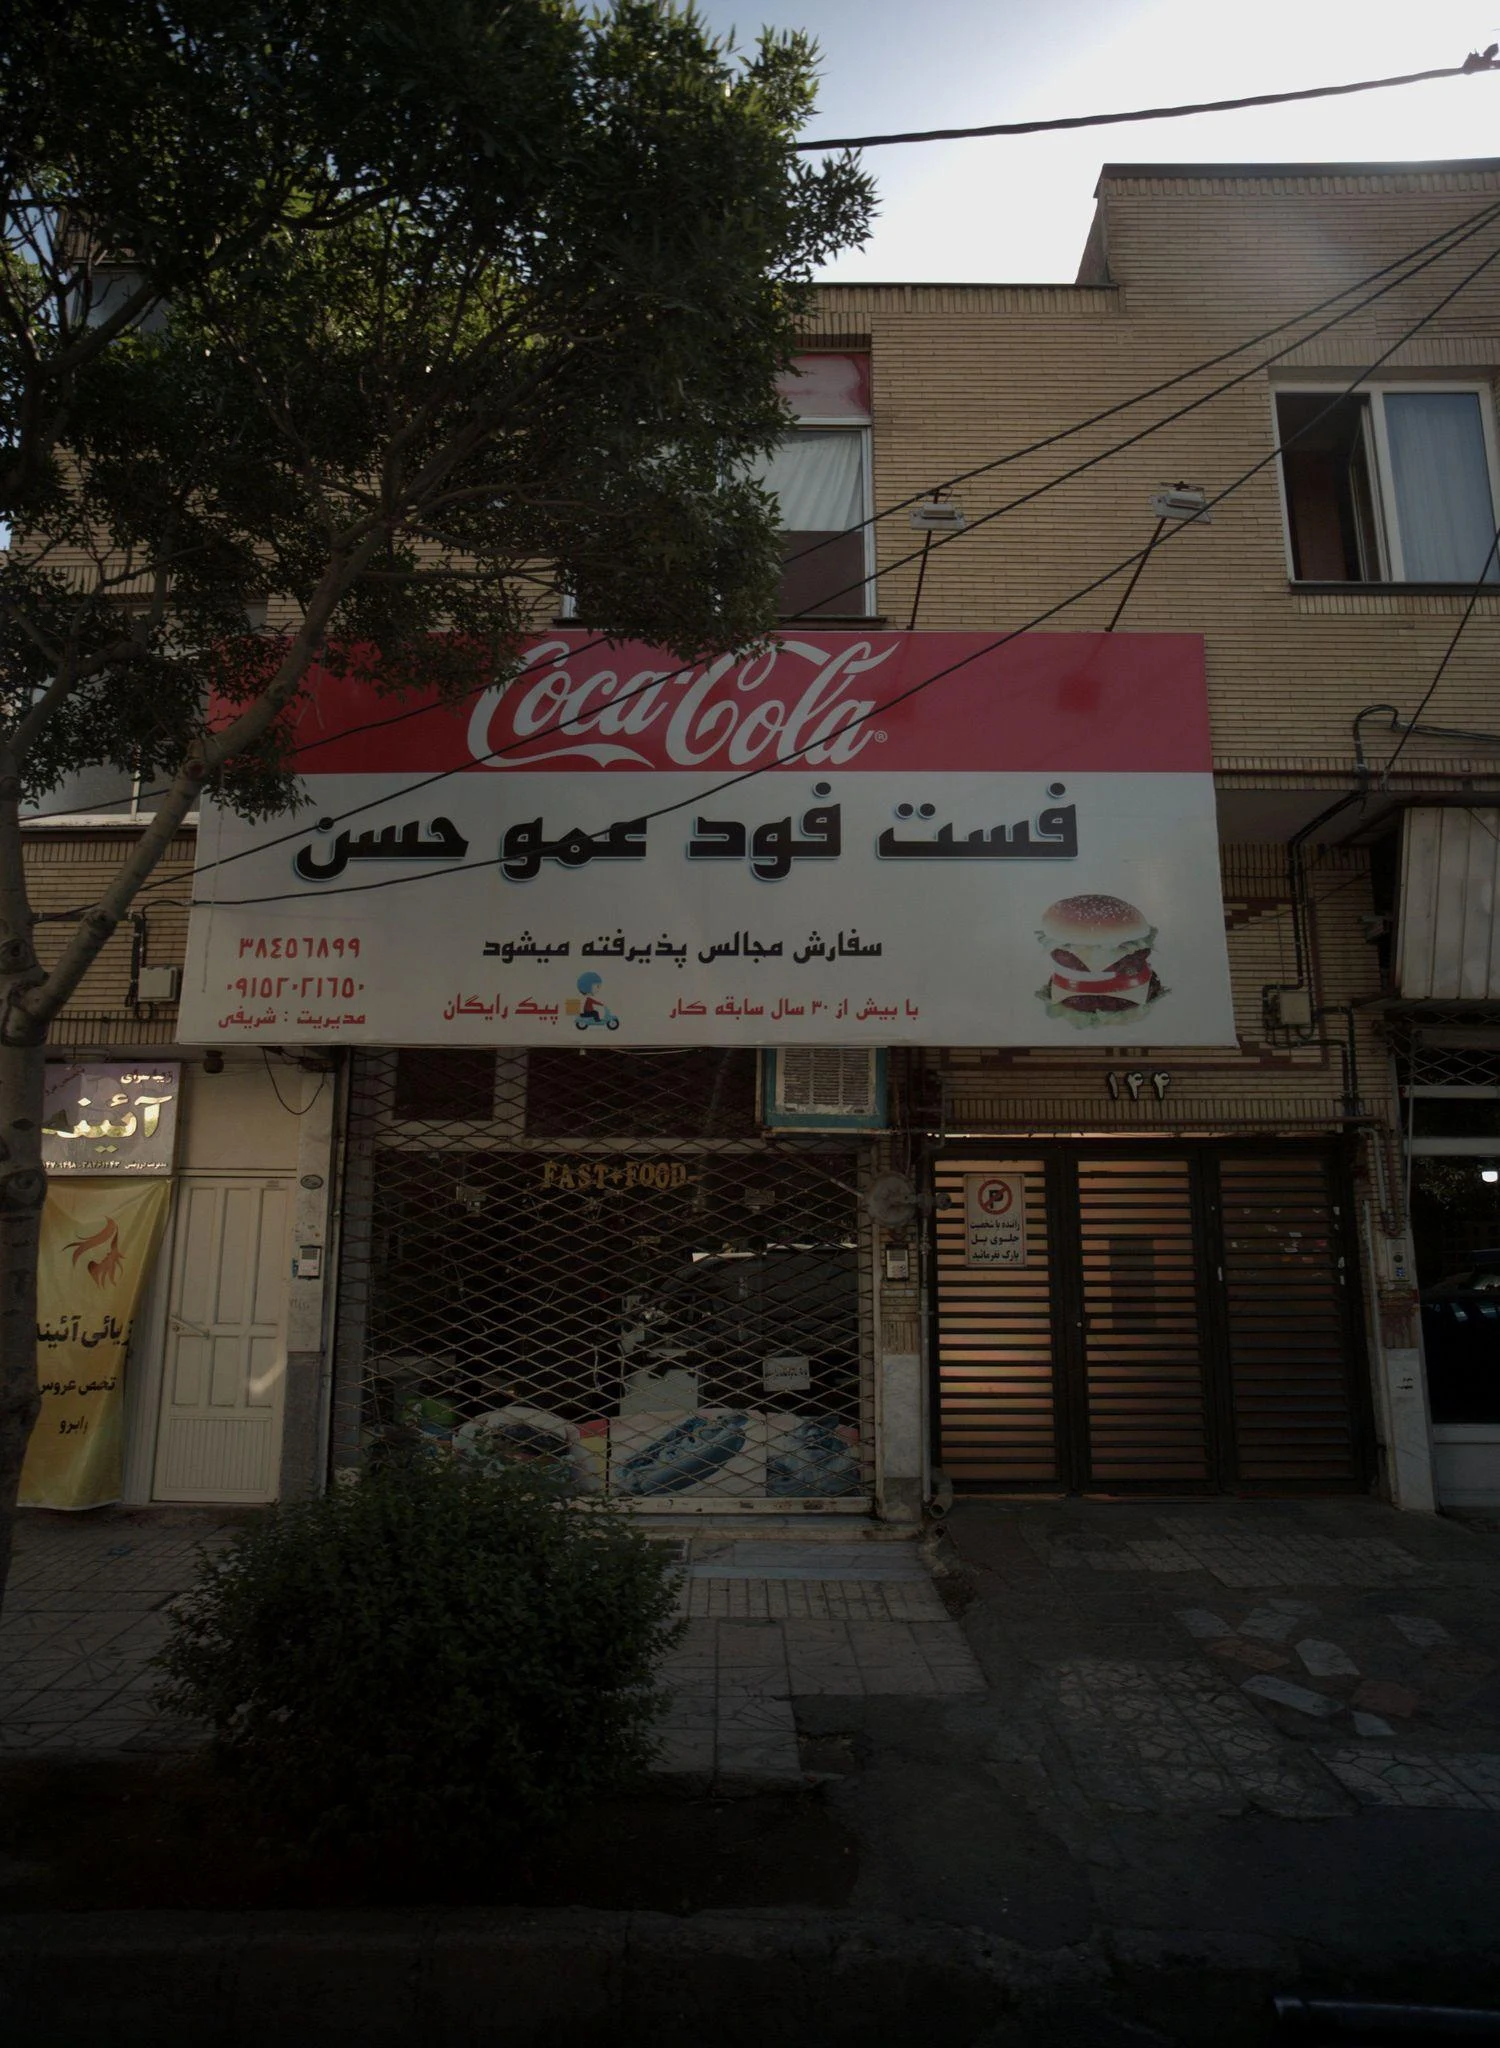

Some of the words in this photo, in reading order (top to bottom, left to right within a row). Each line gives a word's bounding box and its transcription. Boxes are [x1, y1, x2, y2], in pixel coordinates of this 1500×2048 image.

[467, 639, 900, 768] Coca-Cola
[687, 782, 842, 880] فود
[877, 782, 1078, 859] فست
[296, 816, 469, 881] حسن
[502, 816, 647, 881] عمو
[483, 930, 570, 964] میشود
[582, 928, 687, 968] پذیرفته
[698, 931, 783, 964] مجالس
[793, 928, 882, 964] سفارش
[297, 1010, 366, 1029] مدیریت
[443, 993, 508, 1021] رایگان
[515, 997, 559, 1025] پیک
[669, 998, 707, 1019] کار
[715, 996, 764, 1021] سابقه
[771, 998, 804, 1020] سال
[835, 998, 848, 1020] از
[856, 998, 898, 1020] بیش
[906, 998, 919, 1021] با
